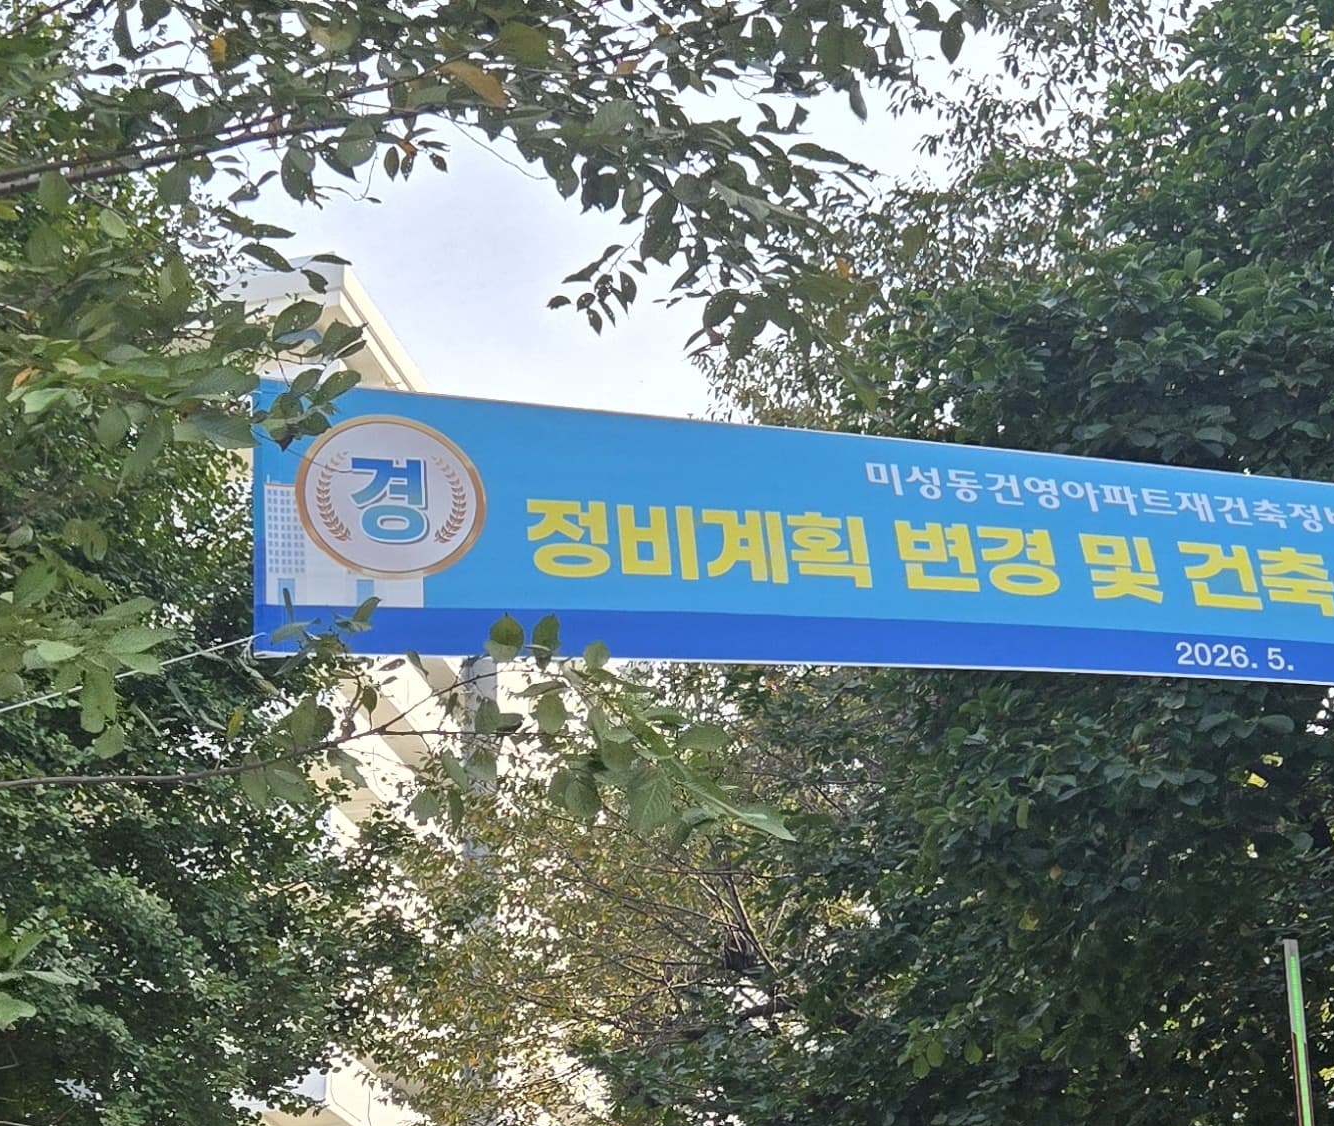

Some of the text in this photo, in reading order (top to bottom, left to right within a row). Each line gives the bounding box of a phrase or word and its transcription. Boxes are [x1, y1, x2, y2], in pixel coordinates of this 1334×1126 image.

[350, 455, 430, 544] 경
[525, 498, 874, 590] 정비계획
[894, 518, 1061, 597] 변경
[1077, 531, 1164, 606] 및
[1175, 641, 1296, 672] 2026. 5.
